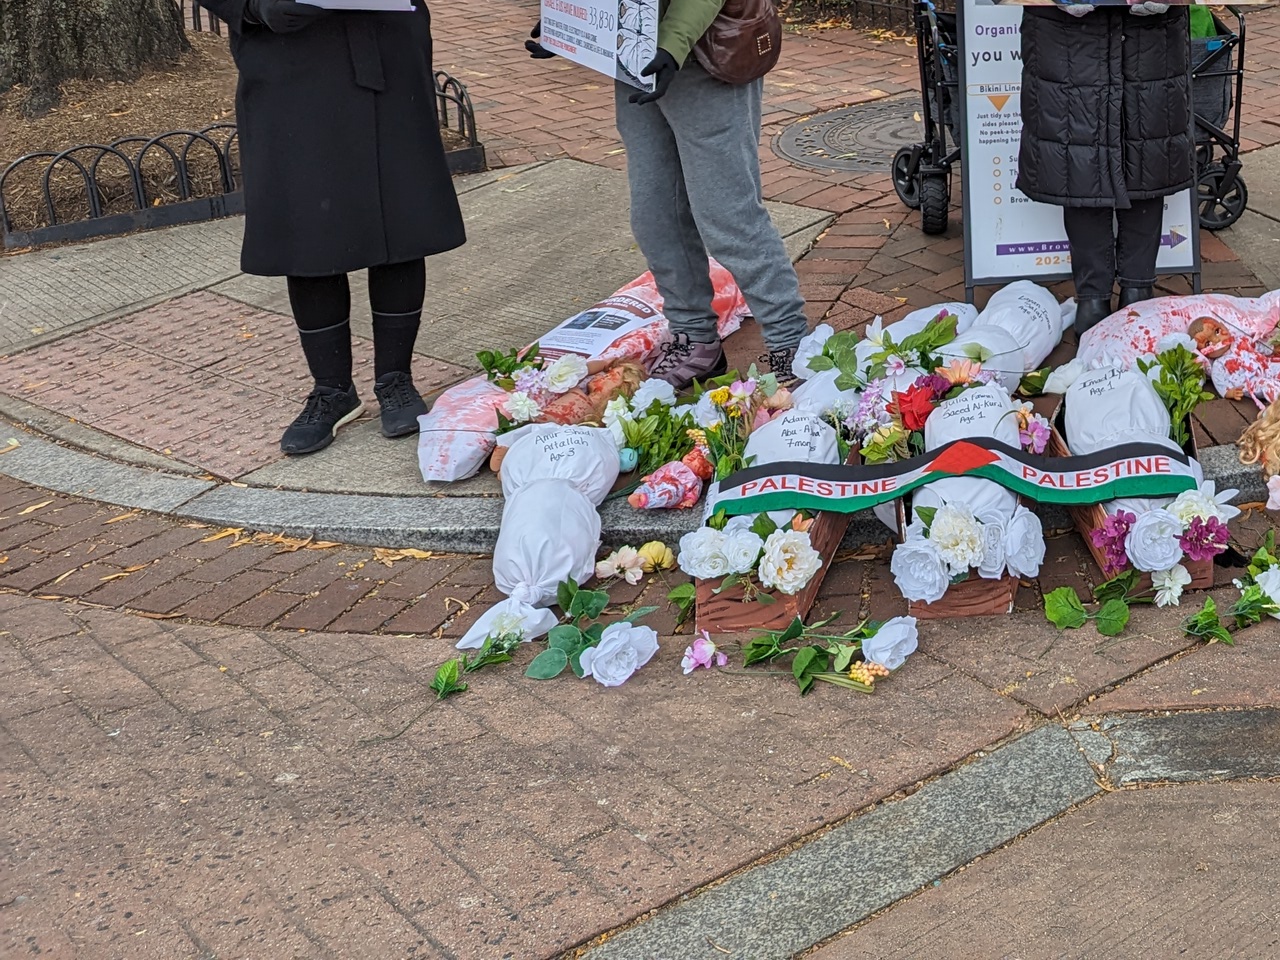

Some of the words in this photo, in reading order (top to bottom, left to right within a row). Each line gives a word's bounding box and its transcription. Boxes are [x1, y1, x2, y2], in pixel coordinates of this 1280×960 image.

[589, 6, 614, 31] 33,830
[972, 51, 1002, 67] you
[1090, 387, 1105, 395] Age
[1107, 381, 1115, 390] 1
[944, 398, 968, 409] Julia
[943, 404, 970, 419] Saeed
[782, 415, 809, 425] Adam
[960, 416, 975, 424] Age
[567, 447, 575, 457] 3
[1022, 457, 1171, 488] PALESTINE
[741, 476, 897, 496] PALESTINE
